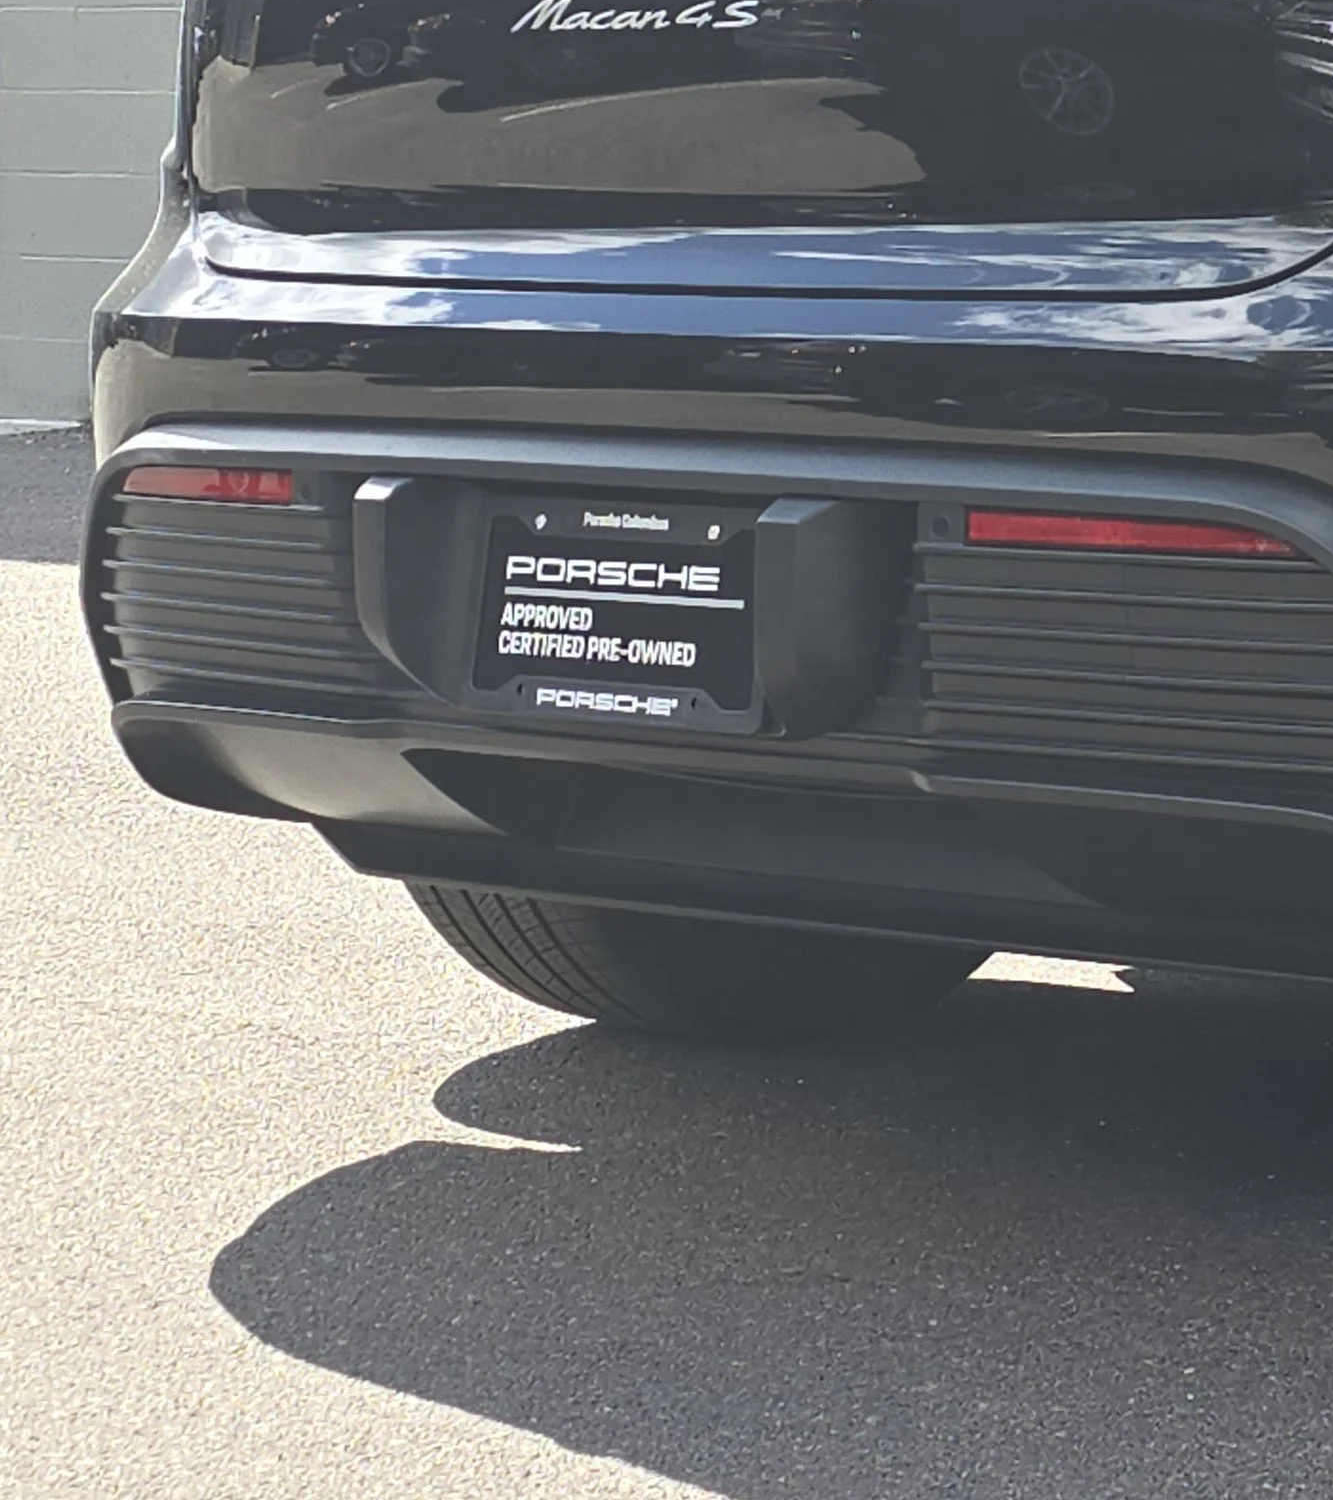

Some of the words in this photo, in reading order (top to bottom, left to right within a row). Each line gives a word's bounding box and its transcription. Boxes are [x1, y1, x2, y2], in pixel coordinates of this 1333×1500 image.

[675, 0, 759, 28] 4S
[506, 556, 720, 591] PORSCHE
[501, 602, 592, 631] APPROVED
[499, 630, 585, 658] CERTIFIED
[586, 636, 696, 667] PRE-OWNED
[536, 688, 678, 716] PORSCHE
